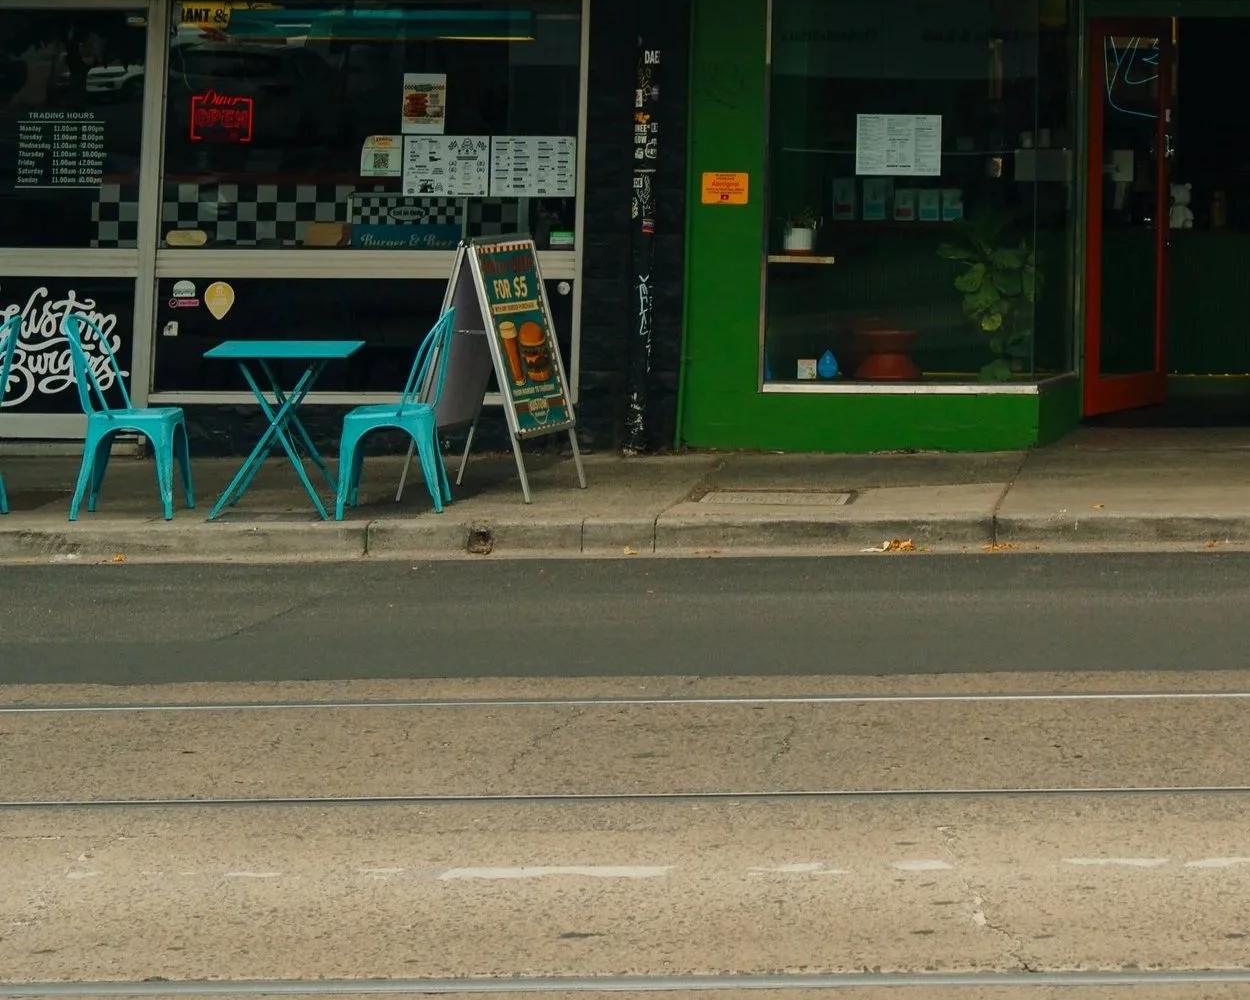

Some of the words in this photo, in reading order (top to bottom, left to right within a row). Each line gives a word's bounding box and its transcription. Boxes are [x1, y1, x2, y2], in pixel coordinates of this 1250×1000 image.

[28, 112, 65, 120] TRADING
[66, 112, 95, 120] HOURS
[194, 108, 248, 129] OPEN
[493, 278, 513, 300] FOR
[513, 275, 528, 298] $5
